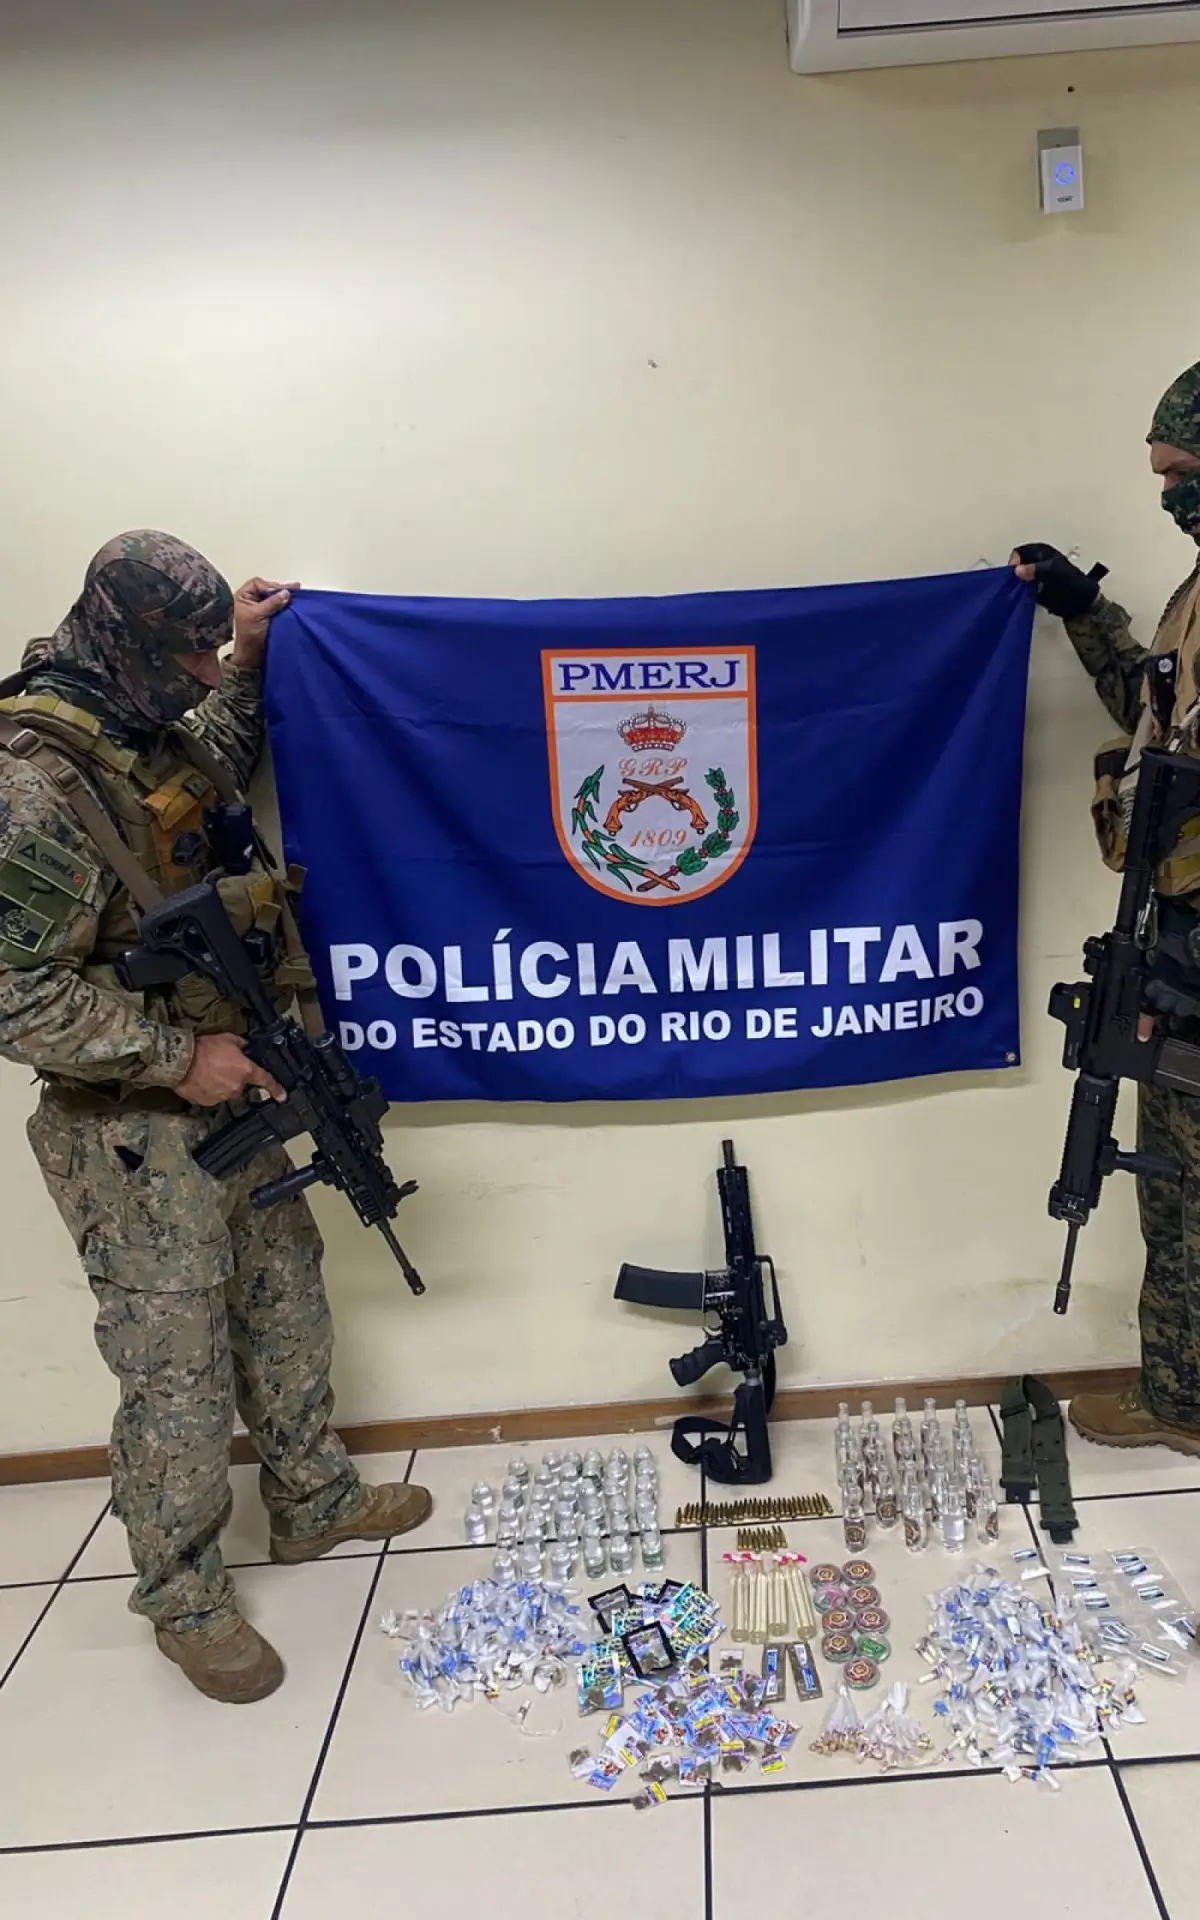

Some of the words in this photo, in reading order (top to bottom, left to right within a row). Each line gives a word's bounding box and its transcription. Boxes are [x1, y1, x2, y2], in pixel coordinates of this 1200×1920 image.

[558, 660, 740, 691] PMERJ
[618, 757, 688, 777] GRP
[629, 829, 687, 848] 1809
[329, 927, 659, 1003] POLÍCIA
[667, 918, 984, 993] MILITAR
[339, 1019, 397, 1051] DO
[412, 1017, 575, 1053] ESTADO
[589, 1013, 647, 1047] DO
[660, 1009, 732, 1042] RIO
[746, 1007, 798, 1039] DE
[811, 986, 984, 1038] JANEIRO
